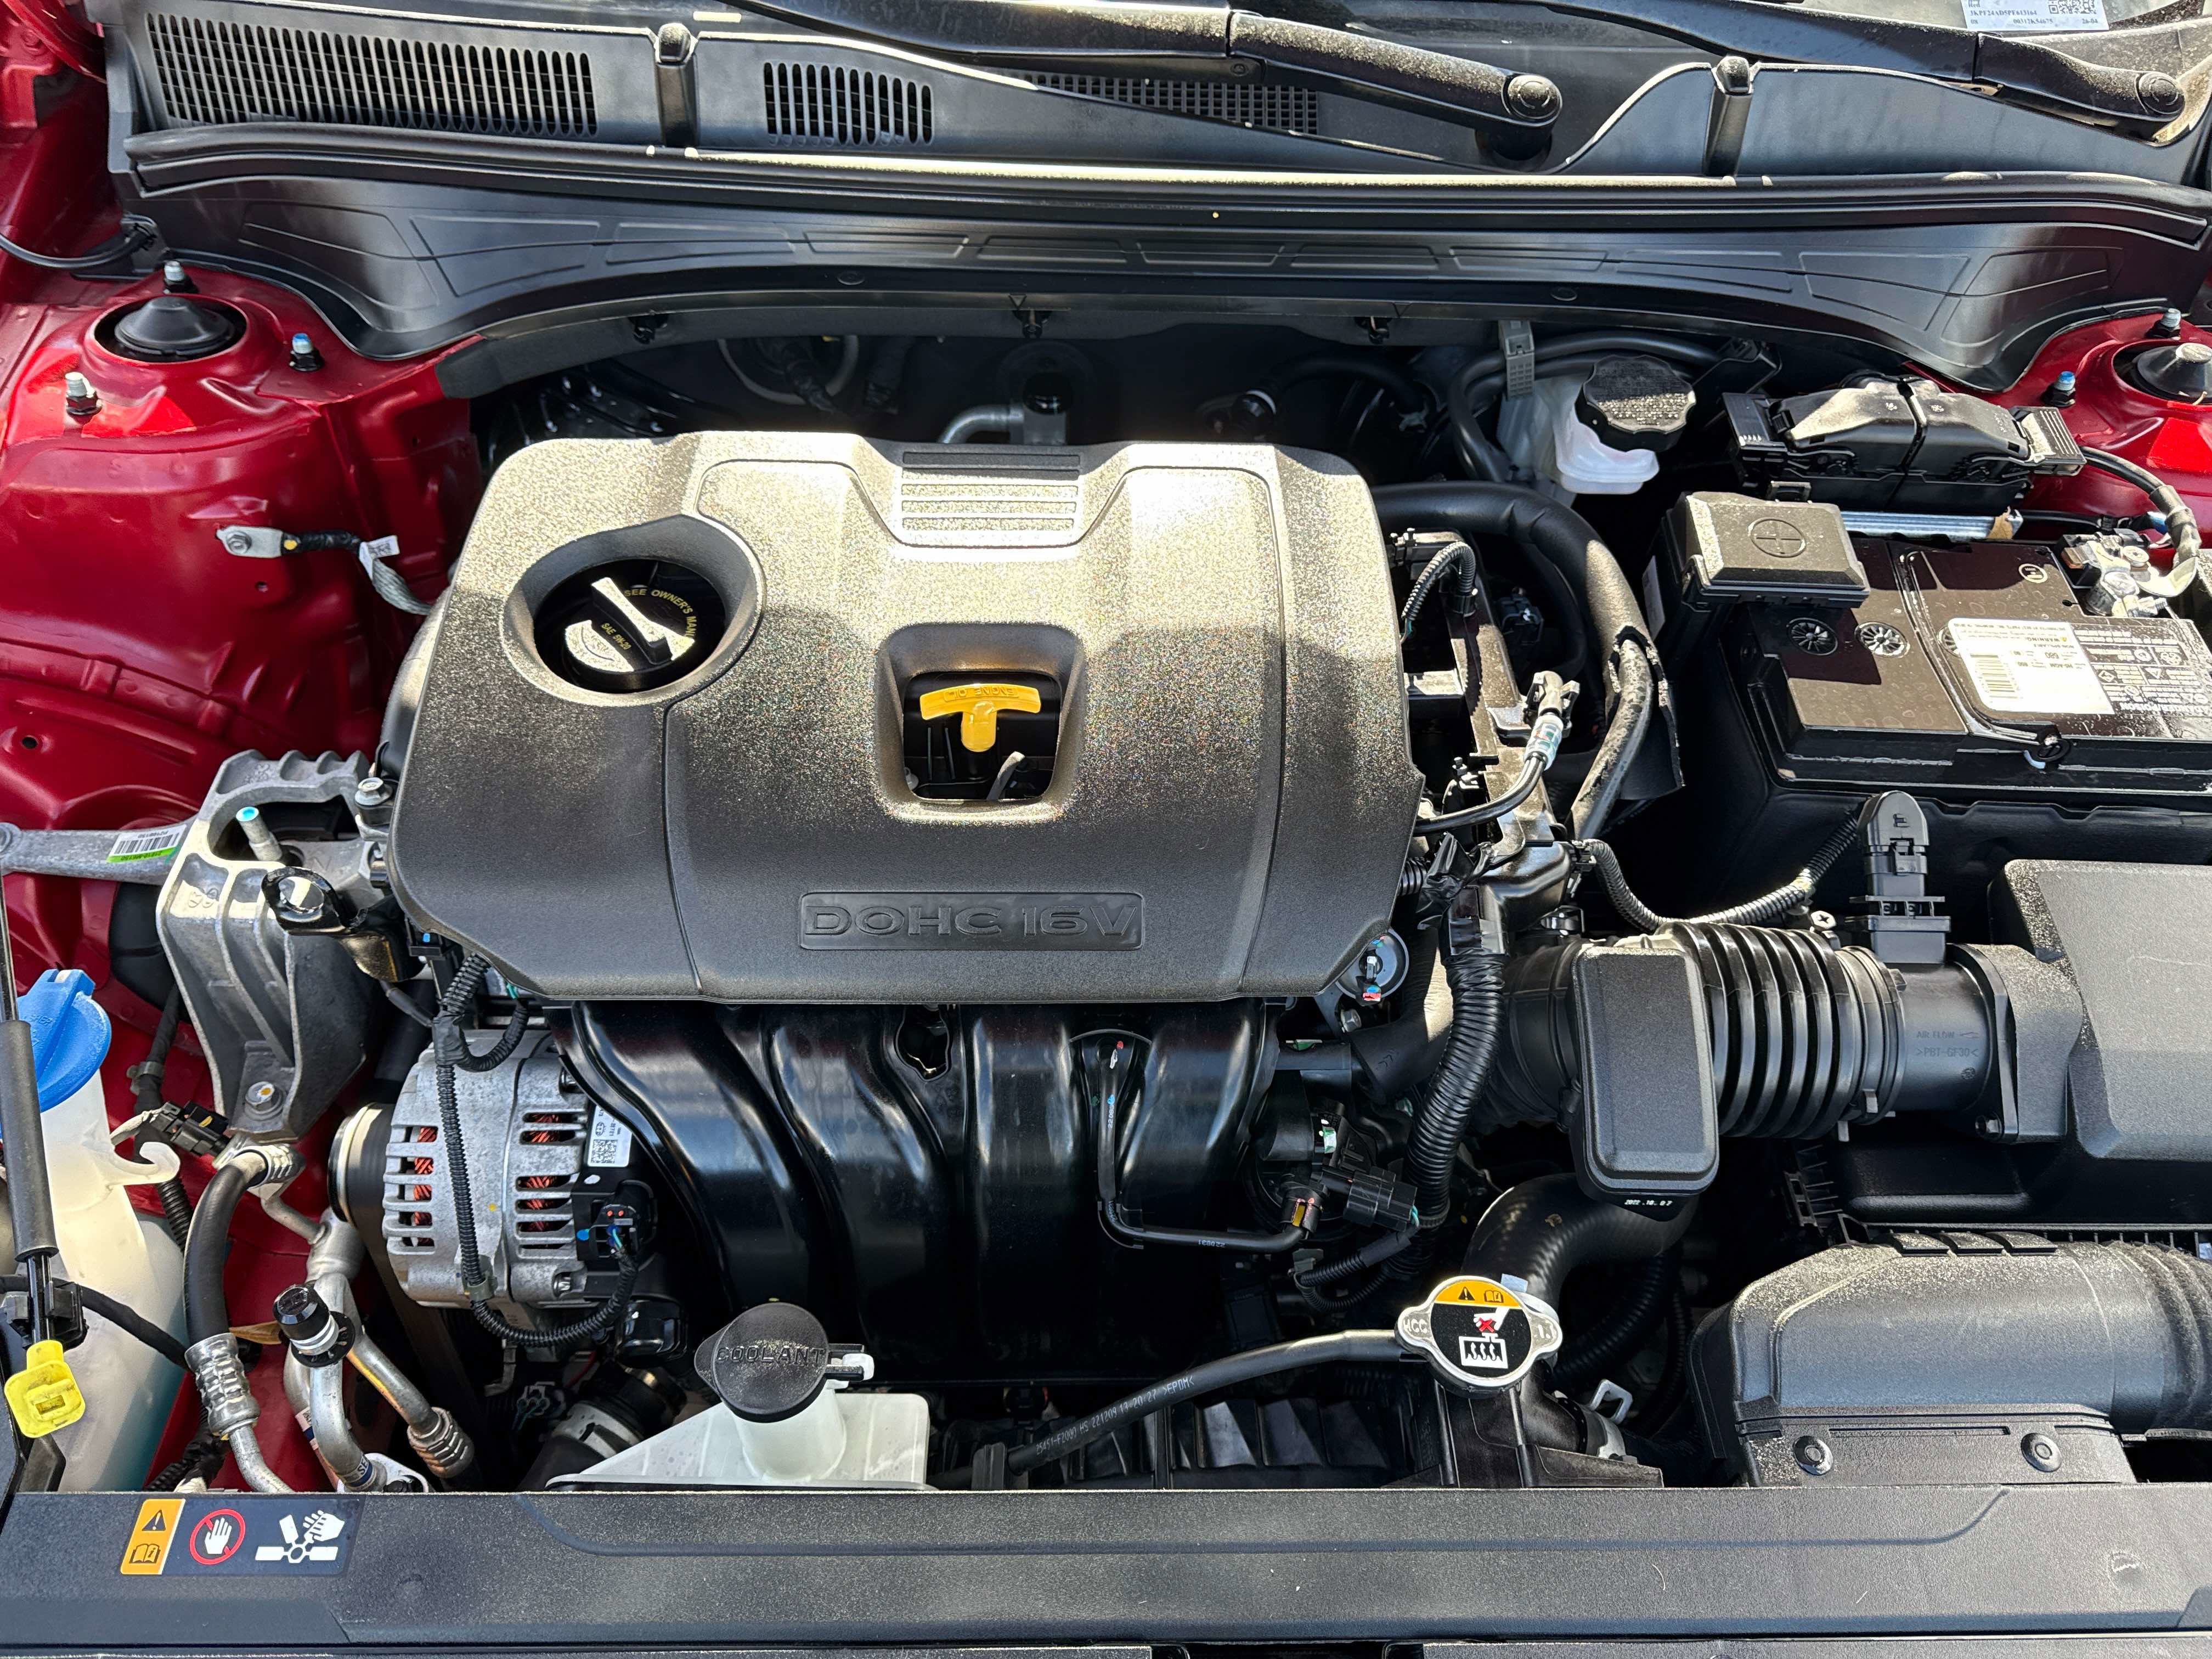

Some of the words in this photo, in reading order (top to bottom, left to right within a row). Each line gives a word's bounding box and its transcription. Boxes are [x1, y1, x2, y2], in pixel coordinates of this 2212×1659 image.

[651, 590, 693, 614] OWNER'S
[601, 623, 616, 635] SAE
[613, 634, 631, 650] 5W-20
[947, 689, 967, 699] OIL
[974, 686, 1014, 696] ENGINE
[805, 905, 1002, 936] DOHC
[1022, 906, 1137, 936] 16V
[1932, 1031, 1955, 1039] FLOW
[1404, 1318, 1428, 1334] HCC
[715, 1345, 825, 1365] COOLANT
[1080, 1421, 1089, 1434] HS
[1092, 1407, 1117, 1427] 221209
[1163, 1375, 1194, 1395] >EPDM<
